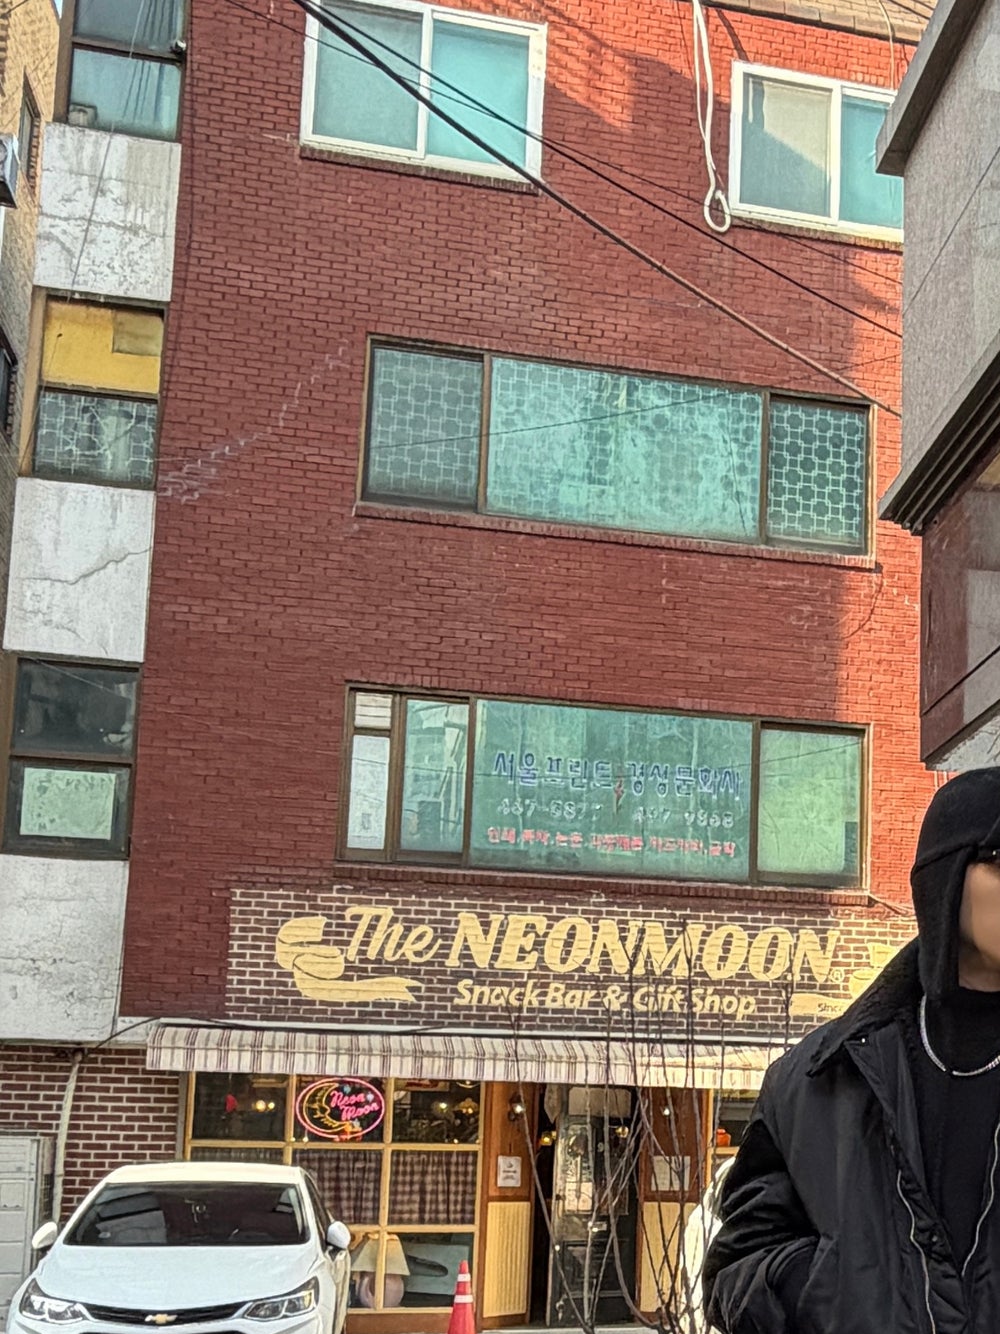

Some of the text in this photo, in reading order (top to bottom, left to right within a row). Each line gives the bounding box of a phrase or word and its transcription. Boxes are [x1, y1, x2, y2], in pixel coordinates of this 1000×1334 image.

[494, 751, 614, 789] 서울프린트
[345, 906, 841, 983] The NEONMOON
[454, 979, 757, 1022] Snack Bar & Gift Shop
